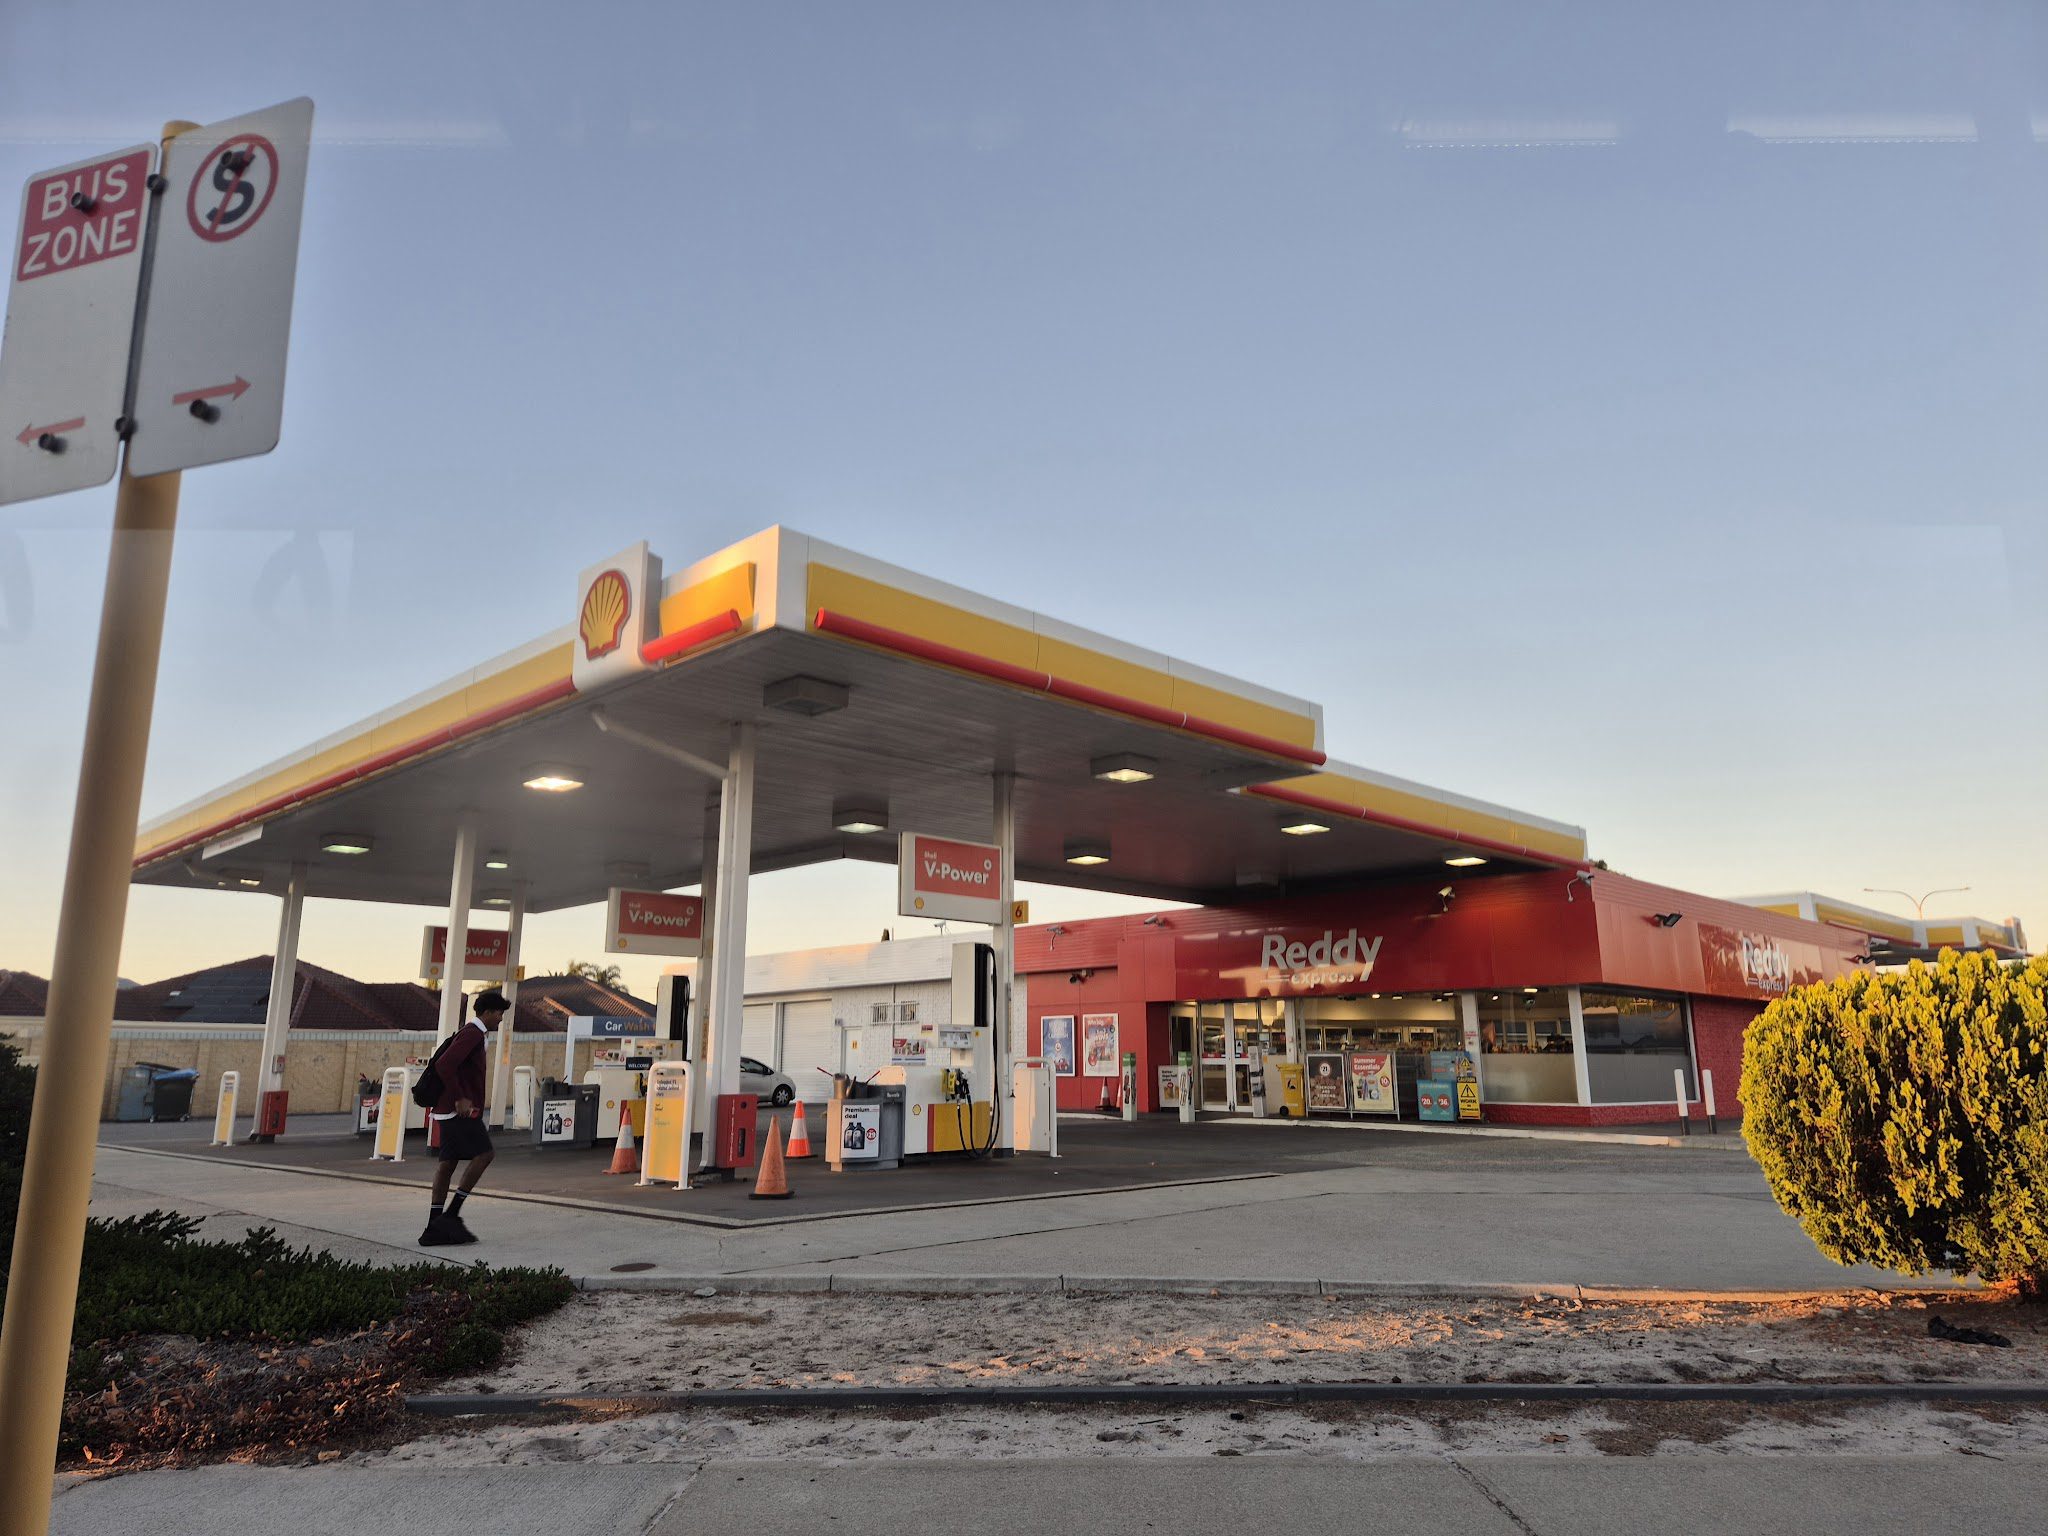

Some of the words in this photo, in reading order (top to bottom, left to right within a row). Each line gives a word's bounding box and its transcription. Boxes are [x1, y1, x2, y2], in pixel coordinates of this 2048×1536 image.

[41, 162, 128, 222] BUS
[22, 208, 137, 275] ZONE
[924, 860, 989, 885] V-Power
[629, 909, 691, 928] V-Power
[1014, 905, 1023, 918] 6
[1261, 928, 1383, 982] Reddy
[1742, 937, 1789, 993] Reddy
[1291, 972, 1355, 988] express
[1759, 980, 1783, 994] express
[605, 1021, 622, 1031] Car
[624, 1021, 650, 1031] Wash
